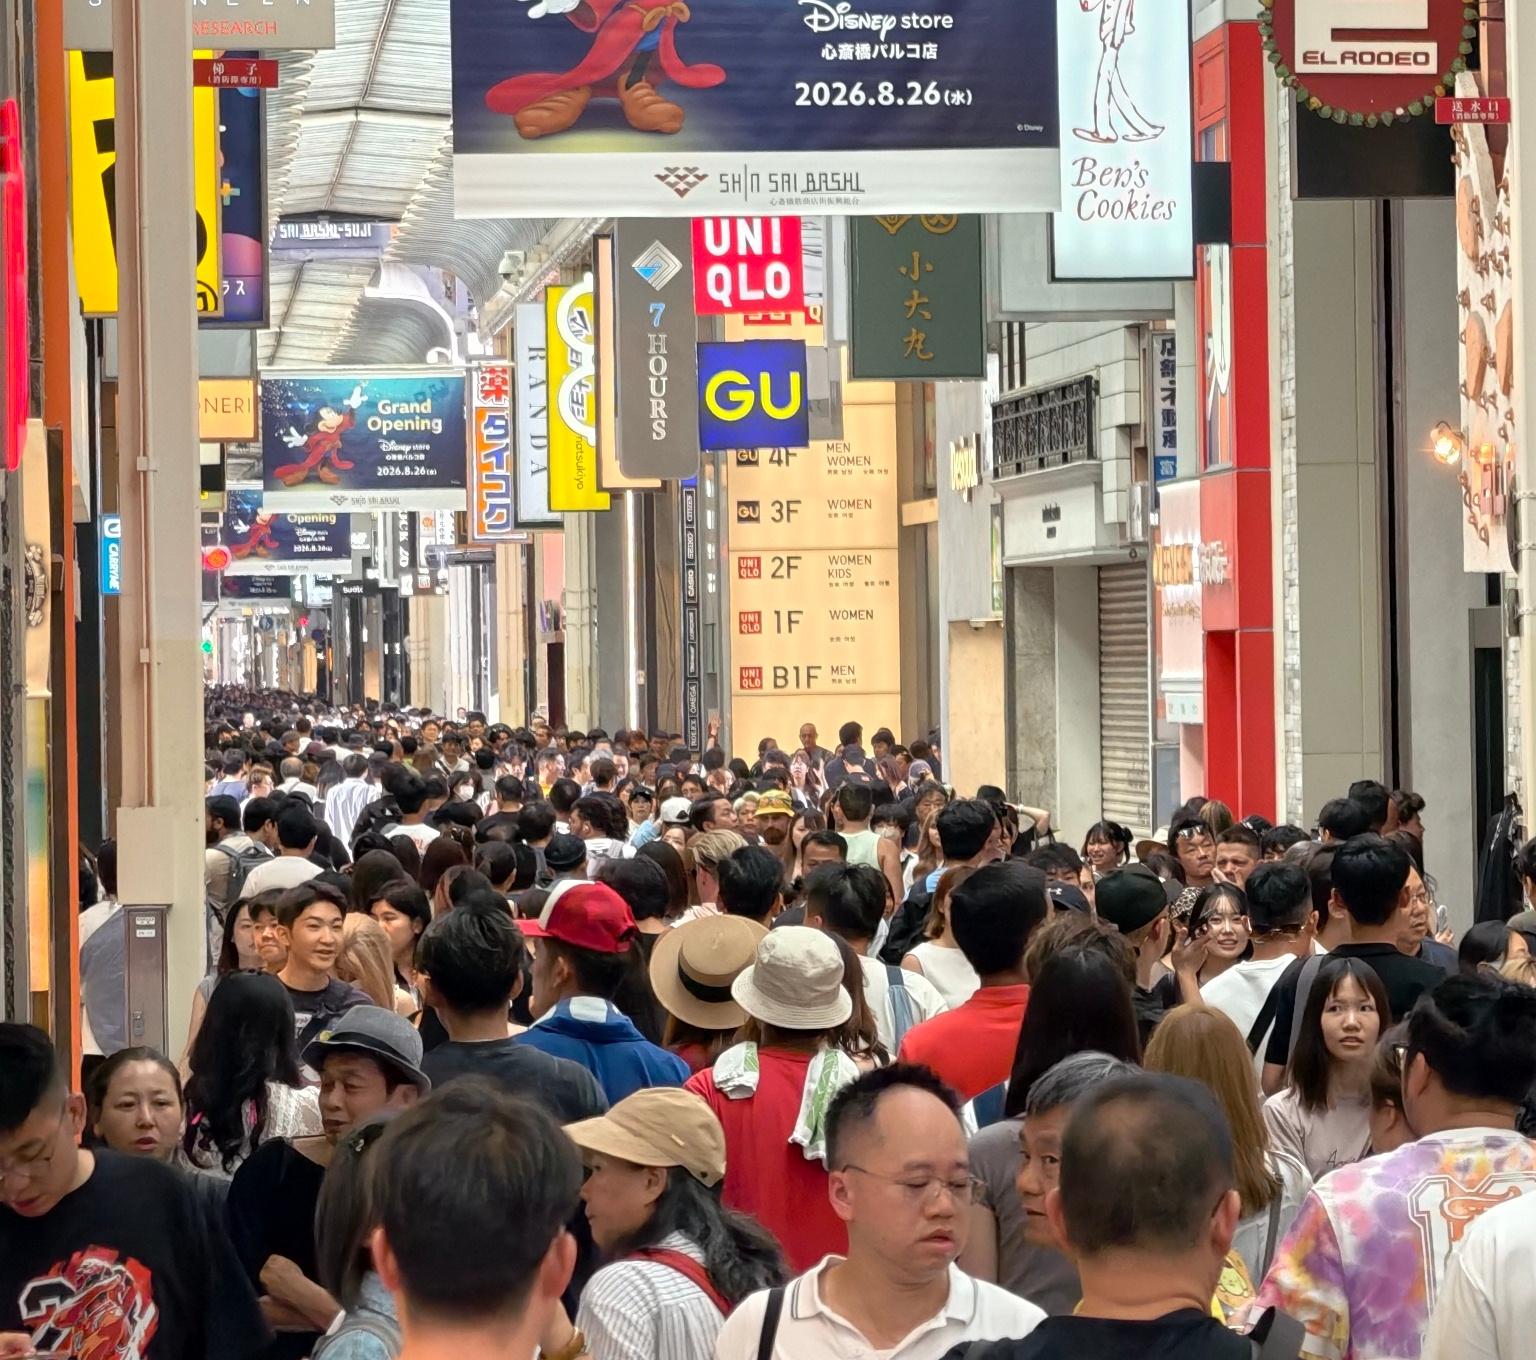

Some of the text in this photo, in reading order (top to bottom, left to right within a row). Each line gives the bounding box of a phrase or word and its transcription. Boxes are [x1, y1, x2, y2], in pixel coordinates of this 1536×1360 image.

[901, 12, 953, 29] store
[821, 43, 938, 60] 心斎橋パルコ店
[1341, 51, 1430, 66] RODEO
[795, 81, 973, 107] 2026.8.26 (水)
[1024, 124, 1043, 132] Disney
[1071, 157, 1149, 188] Ben's
[1077, 189, 1176, 221] Cookies
[704, 219, 781, 256] UNI
[707, 261, 791, 308] QLO
[650, 303, 666, 327] 7
[648, 334, 668, 440] HOURS
[706, 371, 801, 420] GU
[197, 396, 252, 414] NERI
[378, 398, 432, 415] Grand
[528, 346, 547, 477] RANDA
[367, 416, 443, 434] Opening
[827, 443, 851, 453] MEN
[828, 456, 871, 466] WOMEN
[737, 499, 872, 523] GU 3F WOMEN
[740, 555, 872, 579] UNI 2F WOMEN
[740, 568, 852, 579] QLO KIDS
[740, 610, 874, 634] UNI 1F WOMEN
[741, 623, 760, 633] QLO
[742, 669, 760, 678] UNI
[773, 666, 822, 689] B1F
[831, 666, 855, 676] MEN
[742, 678, 761, 688] QLO
